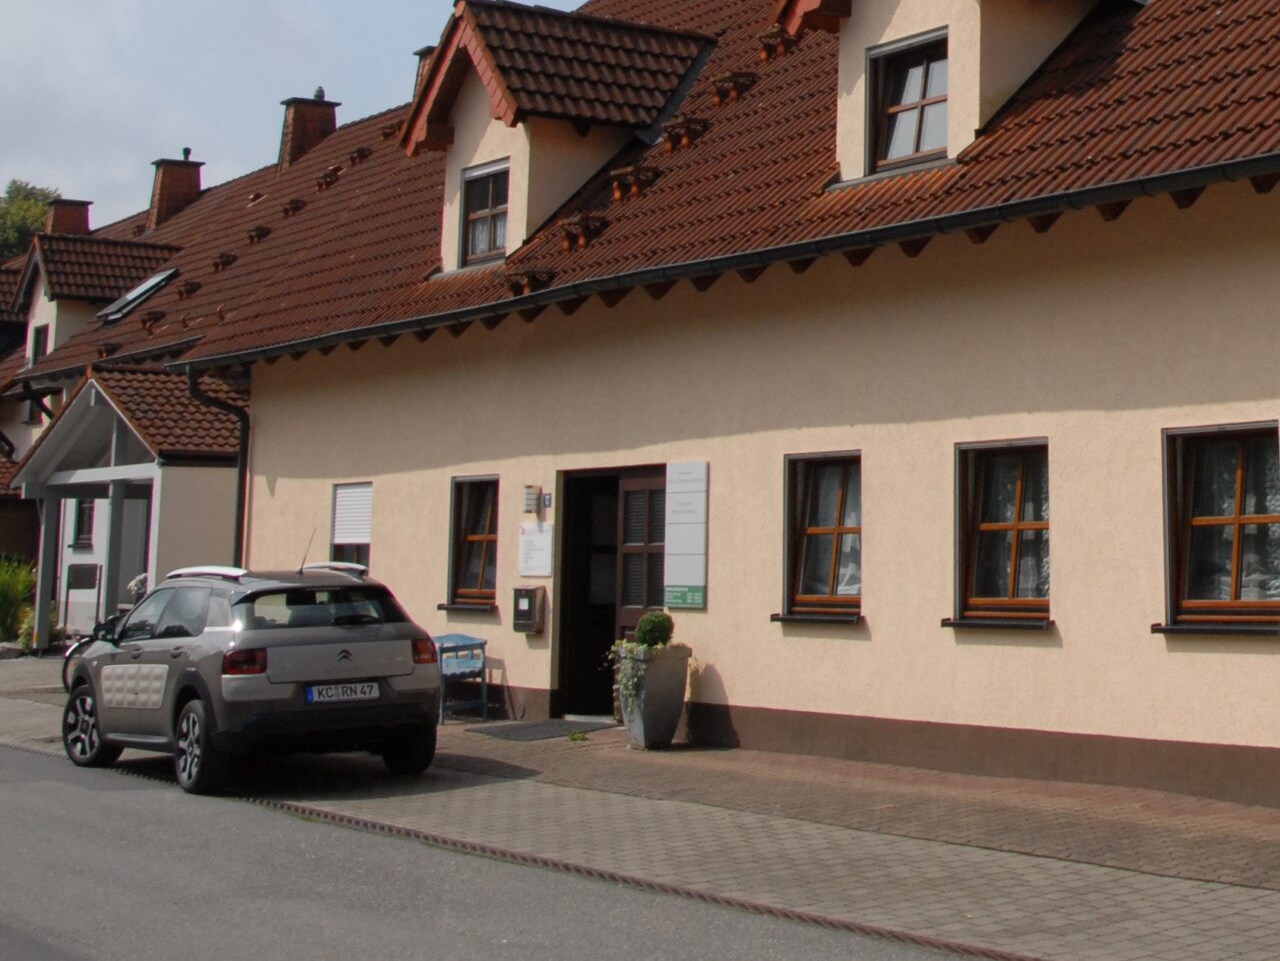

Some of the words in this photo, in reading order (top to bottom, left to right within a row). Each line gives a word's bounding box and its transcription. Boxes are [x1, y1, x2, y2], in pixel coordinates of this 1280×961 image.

[317, 686, 334, 699] KC
[341, 685, 358, 697] RN
[360, 684, 374, 696] 47
